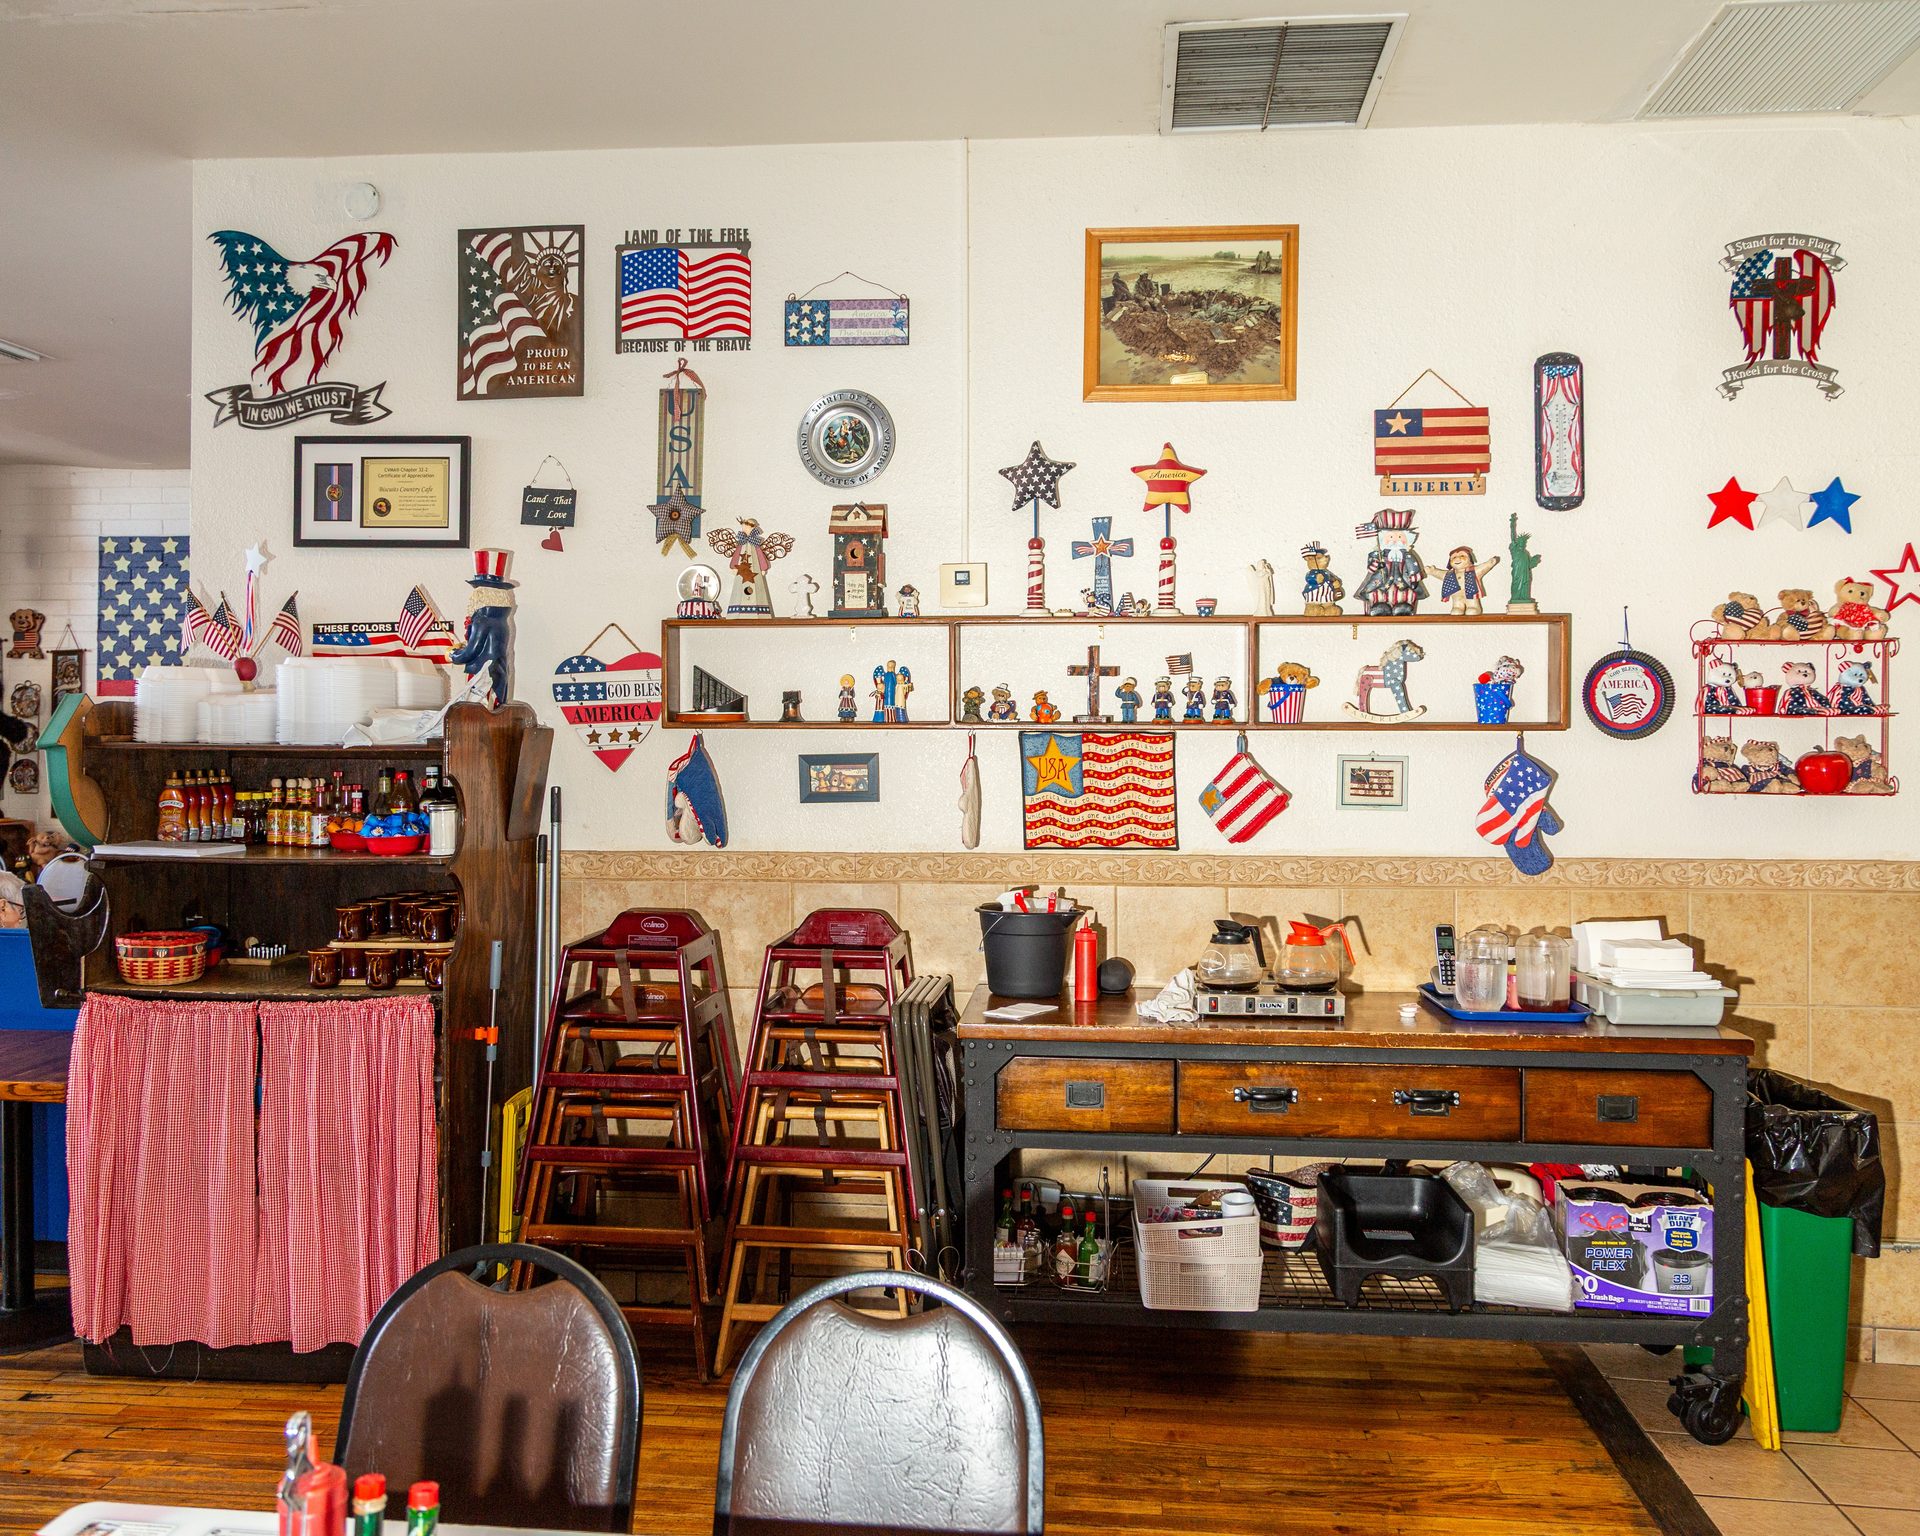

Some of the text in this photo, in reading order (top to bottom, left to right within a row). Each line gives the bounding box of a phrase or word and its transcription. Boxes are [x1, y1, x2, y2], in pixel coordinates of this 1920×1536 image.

[625, 228, 750, 245] LAND OF THE FREE
[1735, 235, 1832, 253] Stand for the Flag
[852, 309, 888, 318] America
[623, 338, 751, 353] BECAUSE OF THE BRAVE
[527, 348, 569, 358] PROUD
[523, 360, 571, 371] TO BE AN
[1732, 364, 1829, 381] Kneel for the Cross
[506, 374, 576, 386] AMERICAN
[246, 391, 348, 422] IN GOD WE TRUST
[811, 393, 845, 415] SPIRIT
[849, 392, 862, 402] OF
[800, 427, 892, 486] UNITED STATES OF AMERICA
[1149, 470, 1188, 480] America
[1391, 481, 1476, 492] LIBERTY
[525, 495, 572, 505] Land That
[534, 510, 567, 519] I Love
[351, 623, 391, 632] COLORS
[1609, 669, 1621, 678] GOD
[607, 681, 662, 698] GOD BLES
[1600, 680, 1649, 691] AMERICA
[572, 704, 654, 723] AMERICA
[1353, 710, 1409, 722] AMERICA
[1094, 744, 1118, 754] Pledge
[1121, 741, 1165, 752] allegiance
[1037, 757, 1068, 782] USA
[1100, 761, 1113, 770] the
[1117, 758, 1133, 768] flag
[1151, 761, 1164, 770] the
[1486, 763, 1506, 787] AMERICA
[1089, 775, 1165, 788] United States of
[1030, 792, 1161, 806] America and to the republic for
[1026, 812, 1047, 821] which
[1103, 811, 1127, 821] nation
[1157, 814, 1171, 822] God
[1069, 831, 1084, 839] with
[1085, 828, 1107, 838] liberty
[1109, 830, 1121, 838] and
[1586, 1247, 1633, 1259] POWER
[1592, 1260, 1626, 1271] FLEX
[1673, 1274, 1691, 1284] 33
[1590, 1293, 1608, 1301] Trash
[1609, 1295, 1625, 1303] Bags
